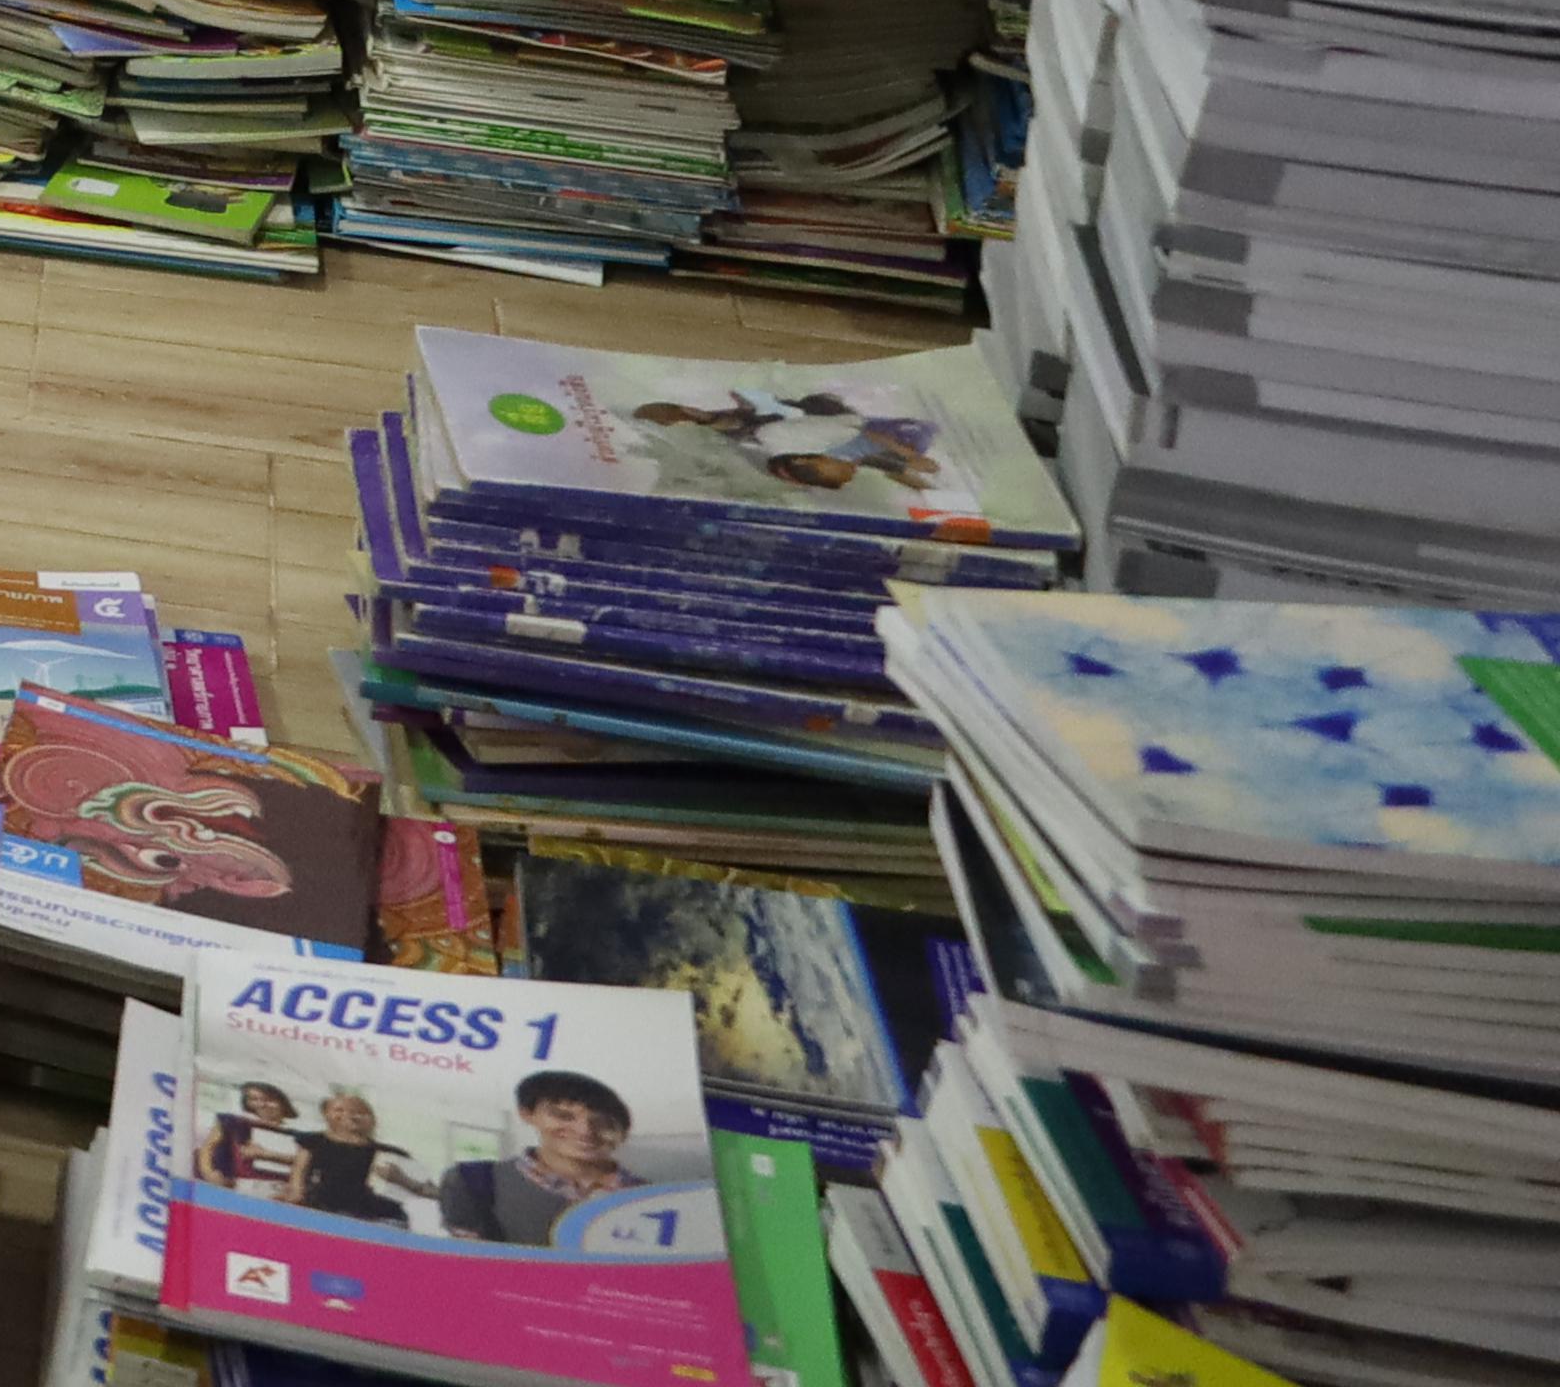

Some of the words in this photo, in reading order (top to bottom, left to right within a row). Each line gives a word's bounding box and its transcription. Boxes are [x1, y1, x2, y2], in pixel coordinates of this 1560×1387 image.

[225, 1010, 380, 1056] Student's
[387, 1043, 475, 1073] Book
[231, 978, 504, 1051] ACCESS
[526, 1012, 559, 1061] 1
